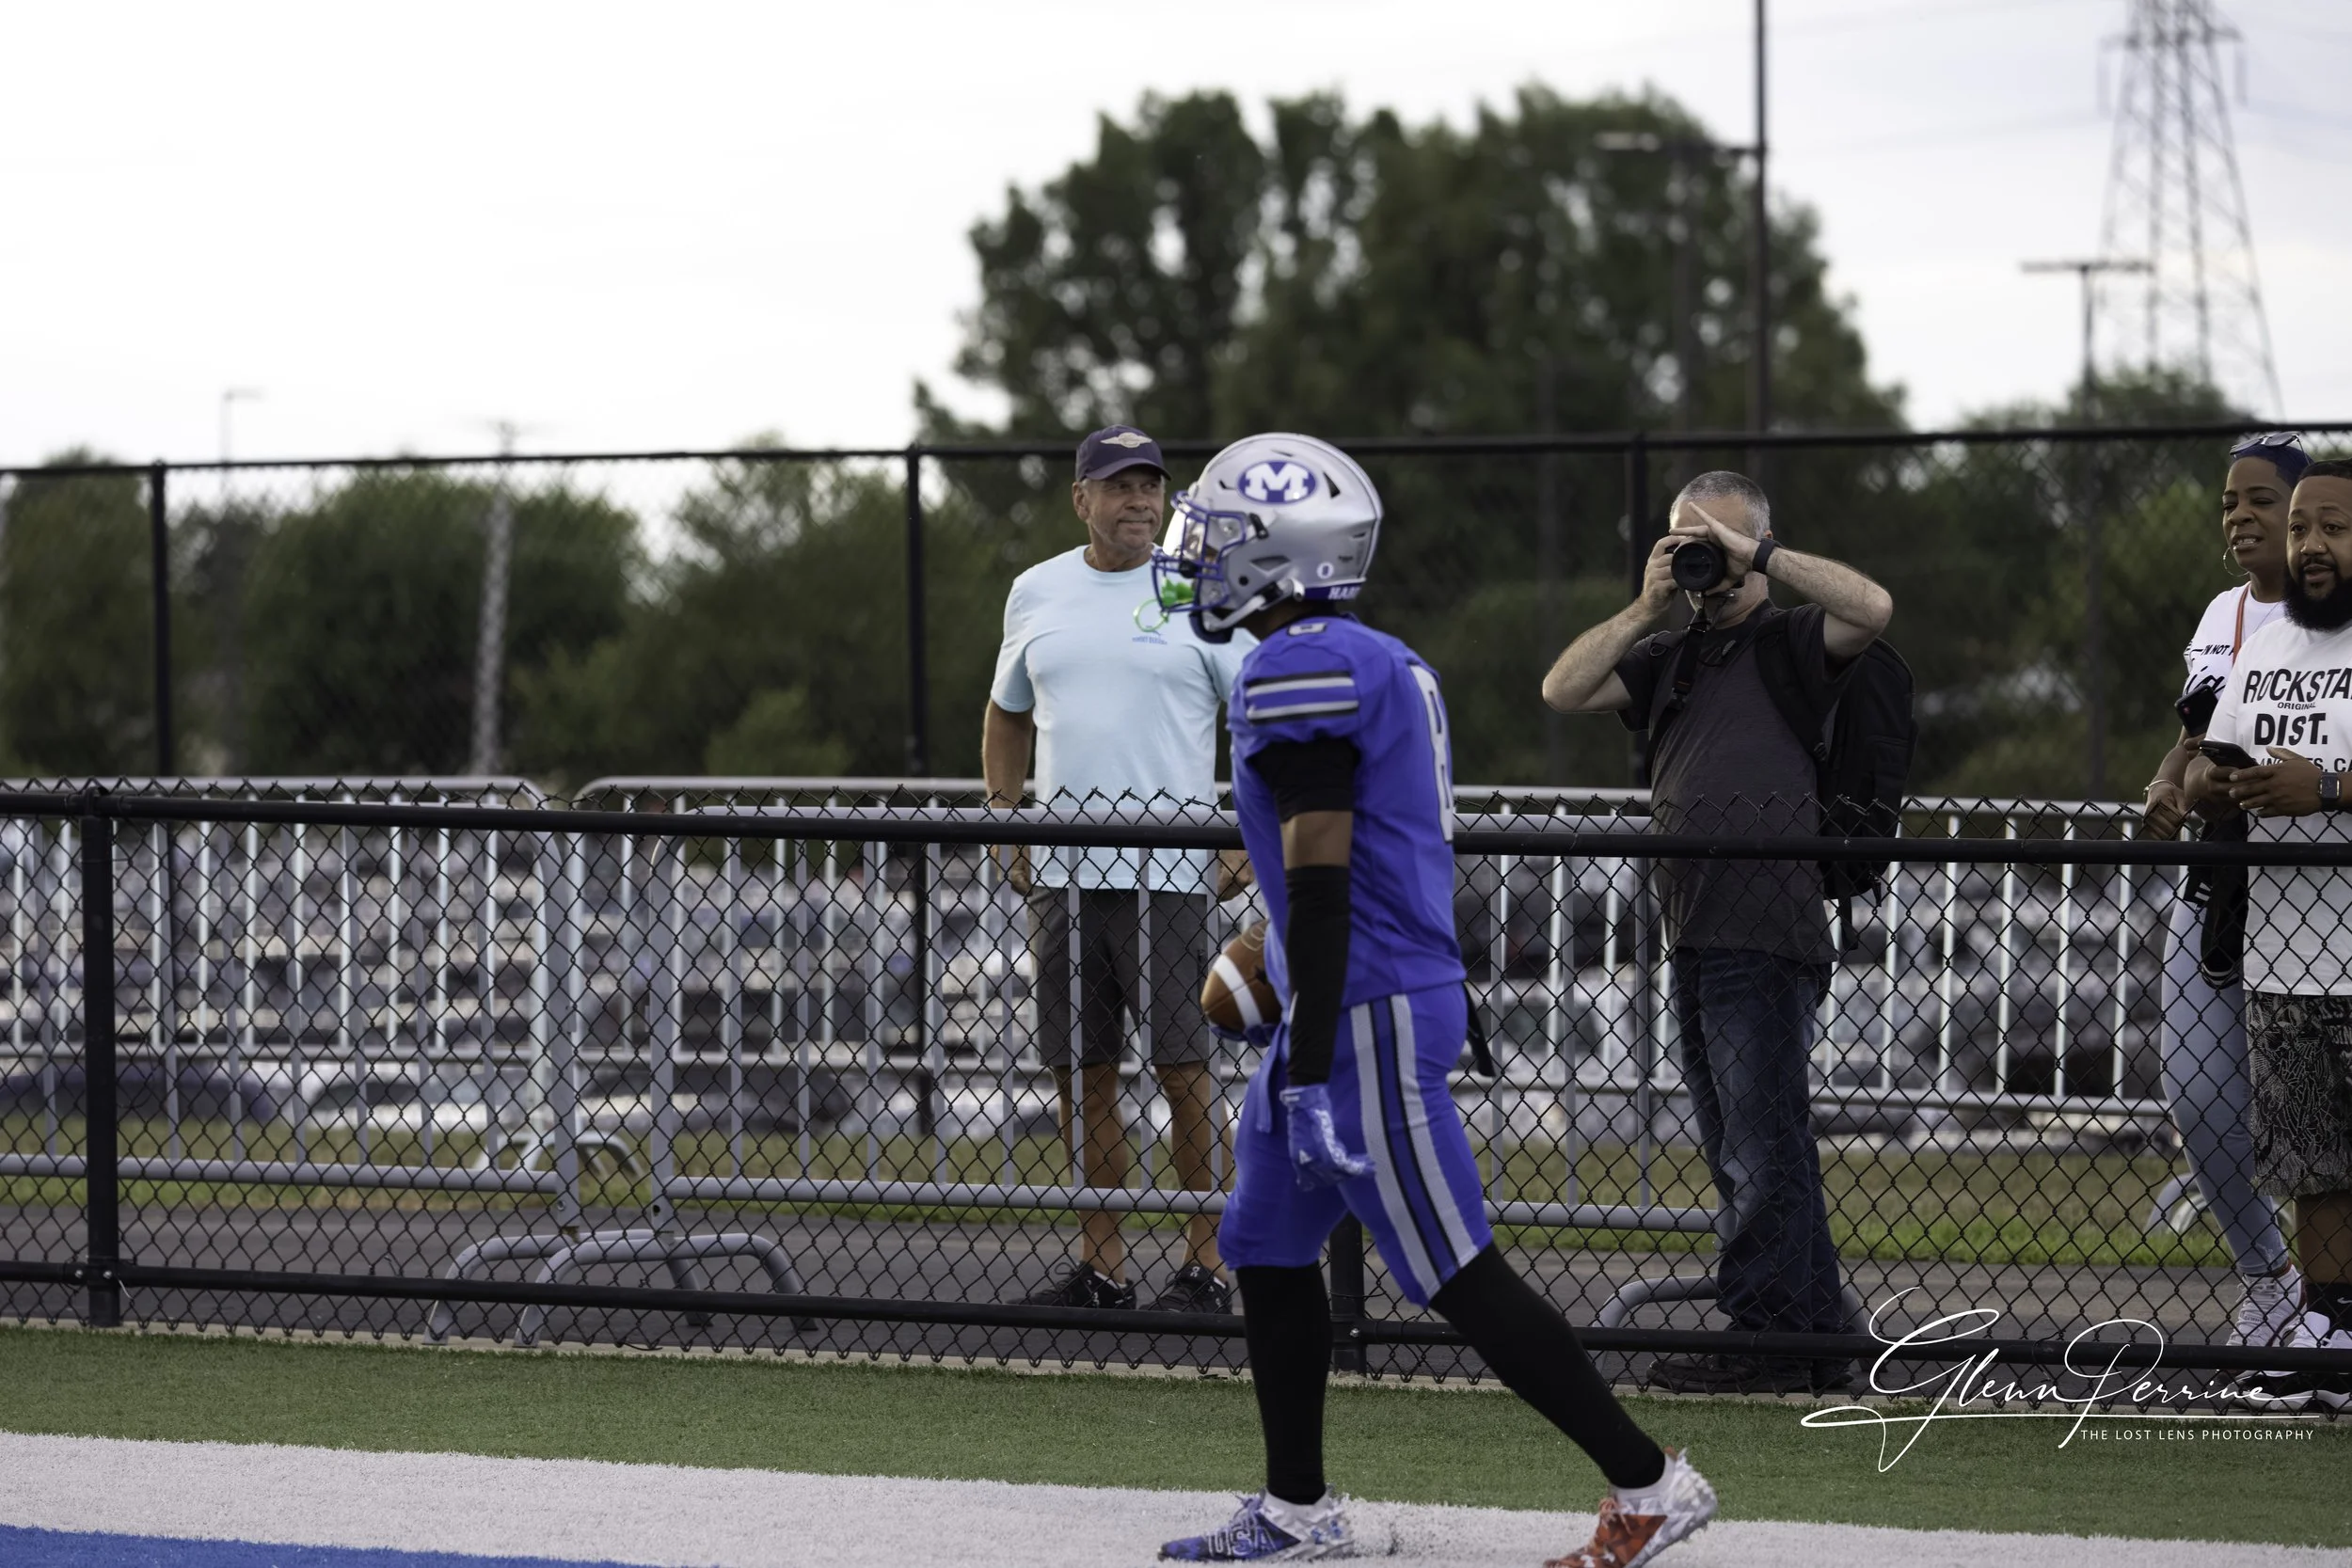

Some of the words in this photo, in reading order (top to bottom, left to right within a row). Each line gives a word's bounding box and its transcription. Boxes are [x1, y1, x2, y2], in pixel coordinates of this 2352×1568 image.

[1244, 462, 1311, 502] M
[2210, 644, 2231, 656] NOT
[2243, 668, 2352, 704] ROCKSTA
[2277, 702, 2316, 710] ORIGINAL
[2254, 713, 2328, 746] DIST.
[1206, 1526, 1279, 1557] USA
